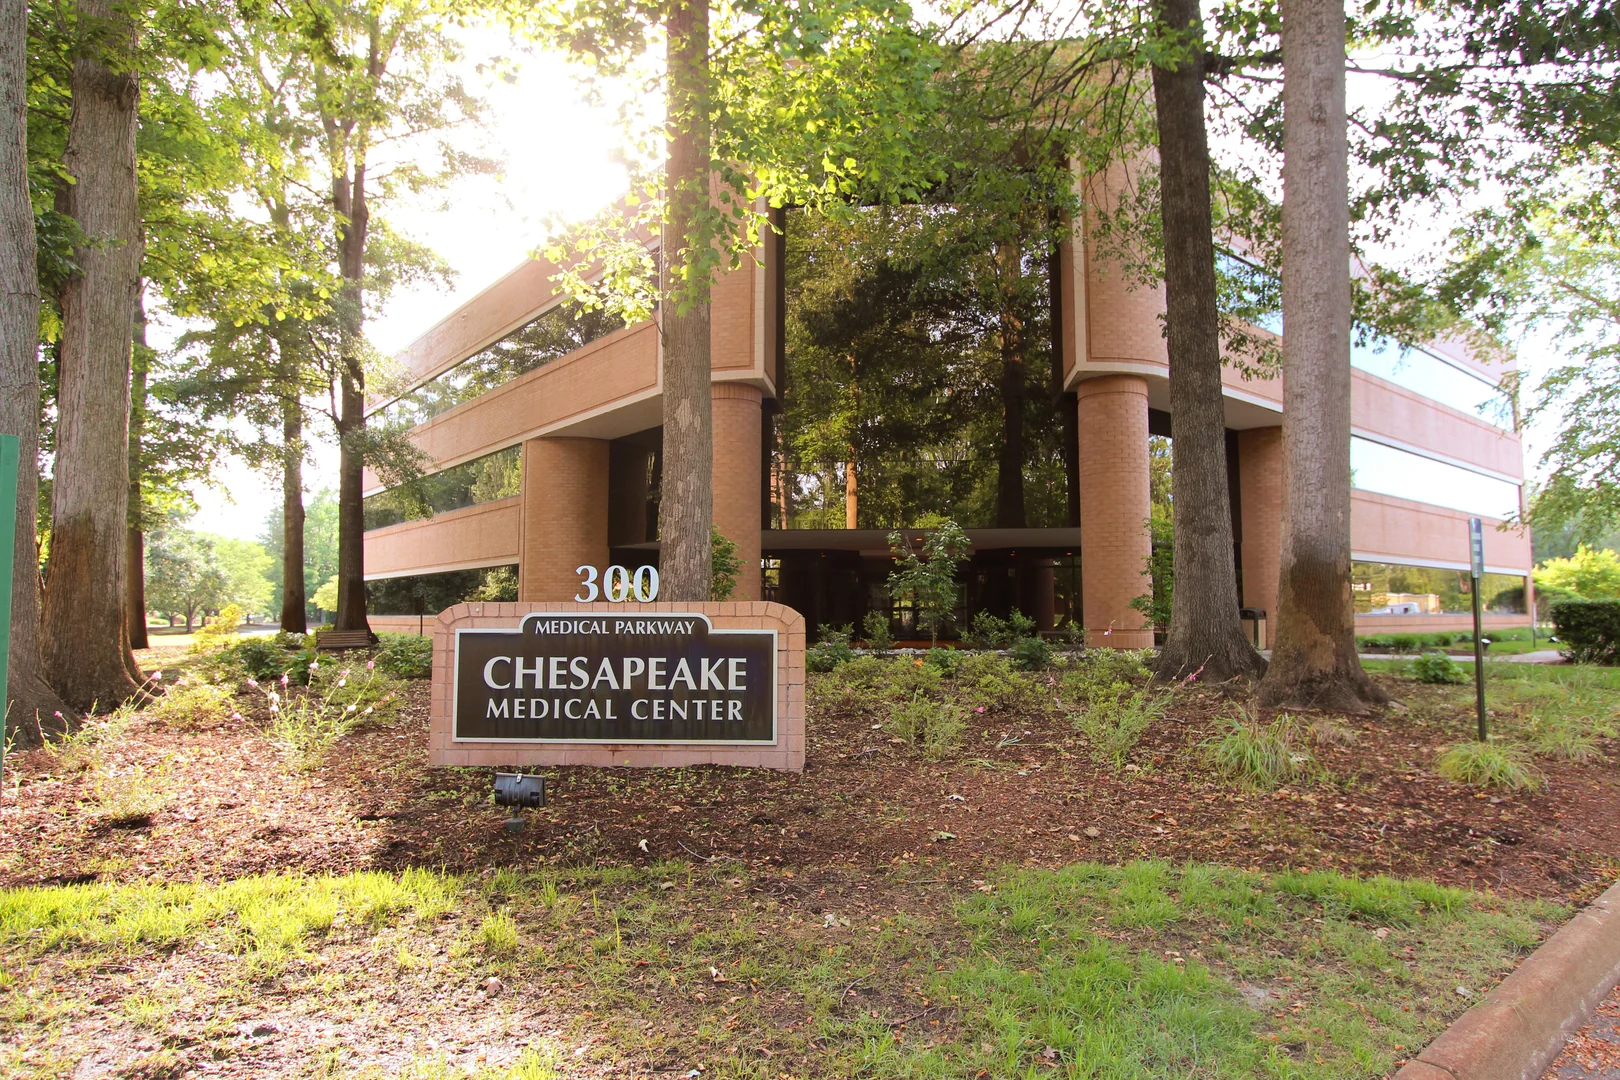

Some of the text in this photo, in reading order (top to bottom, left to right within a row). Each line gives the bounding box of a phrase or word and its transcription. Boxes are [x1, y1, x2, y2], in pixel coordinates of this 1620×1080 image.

[574, 565, 660, 602] 300
[535, 620, 695, 635] MEDICAL PARKWAY
[483, 656, 747, 691] CHESAPEAKE
[486, 698, 743, 721] MEDICAL CENTER
